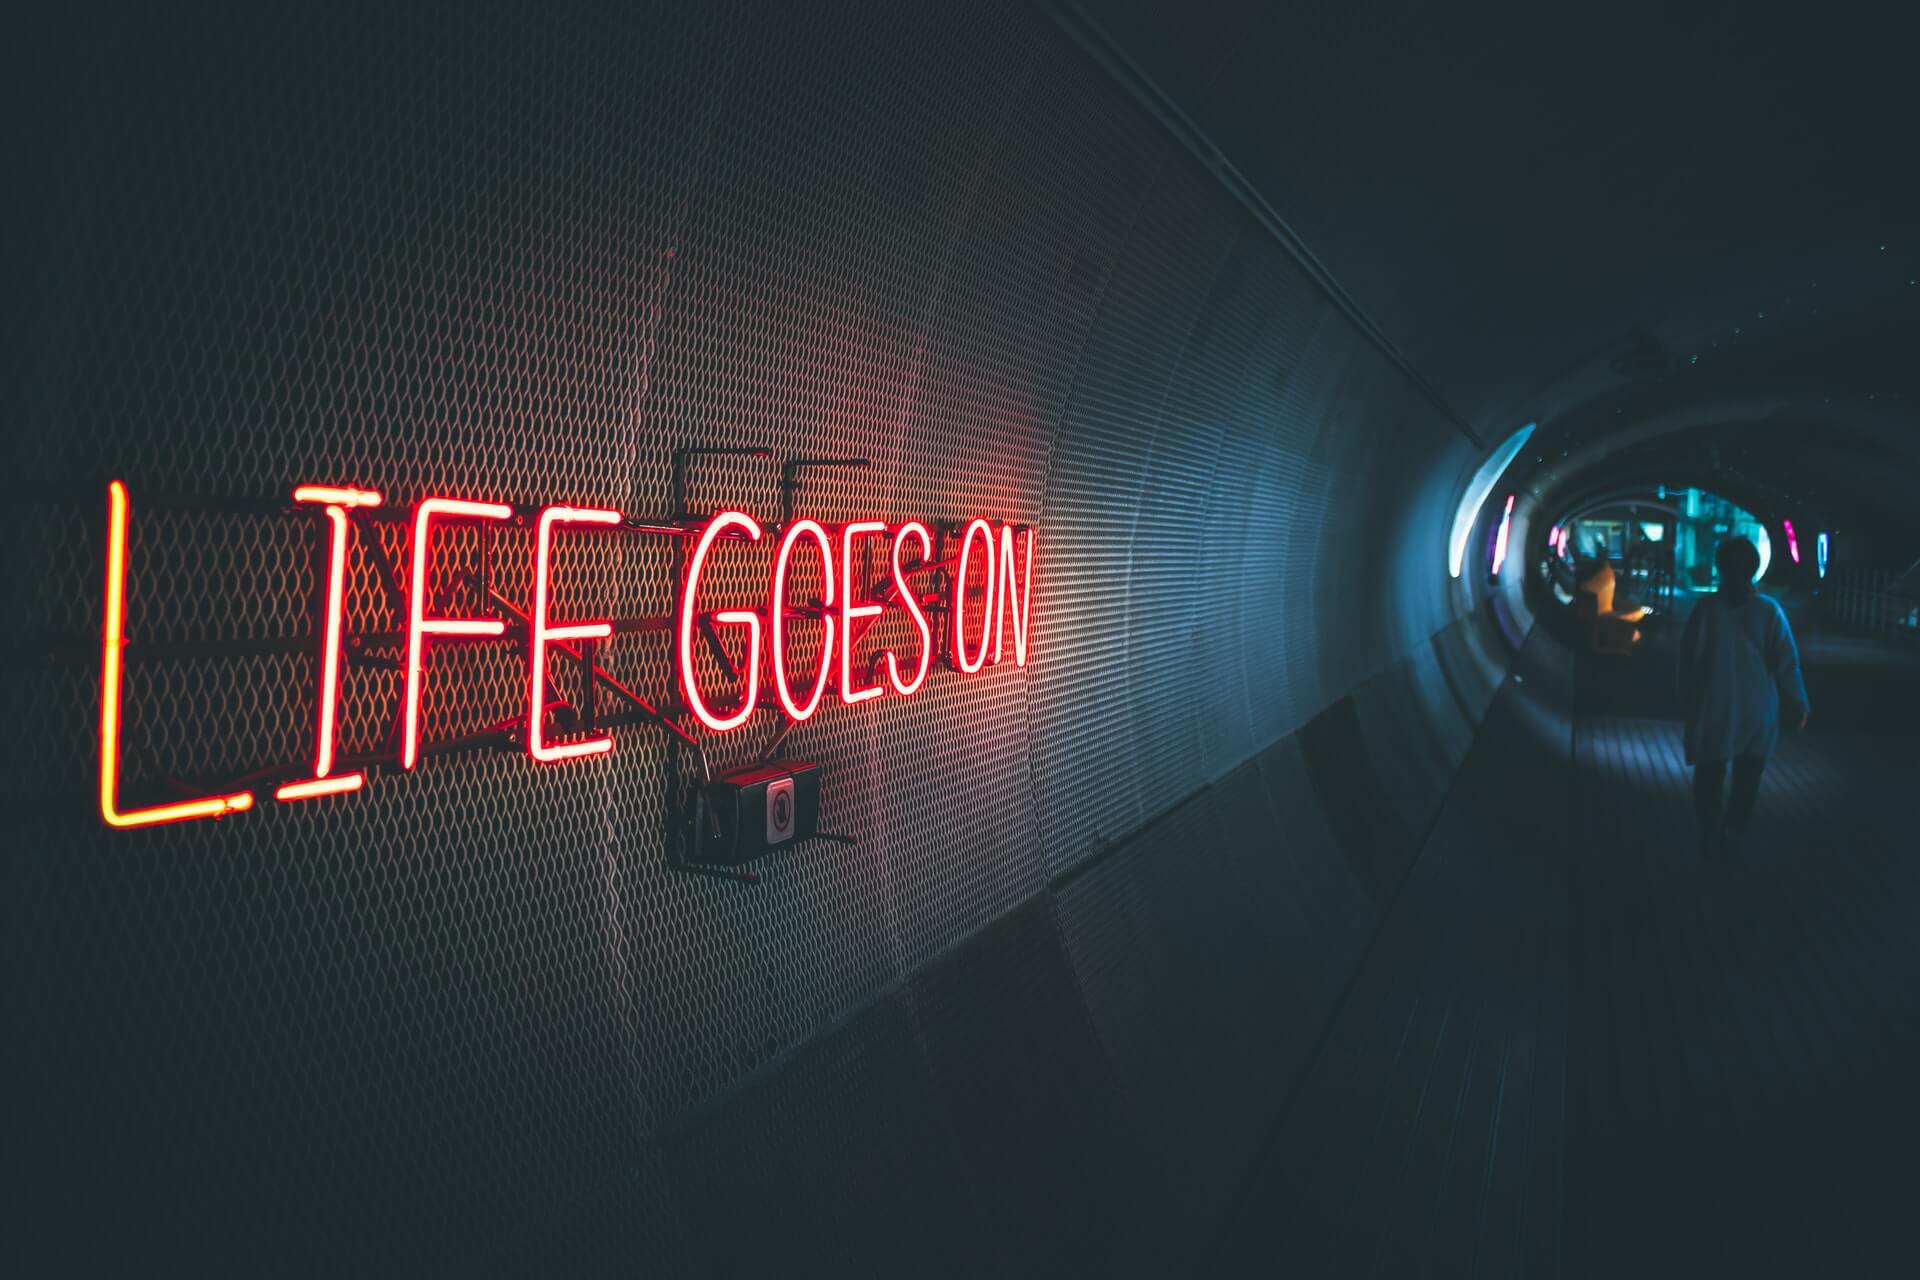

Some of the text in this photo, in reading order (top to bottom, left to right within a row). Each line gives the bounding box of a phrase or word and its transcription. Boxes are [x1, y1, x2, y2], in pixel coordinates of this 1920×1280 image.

[101, 480, 1034, 827] LIFE GOES ON
